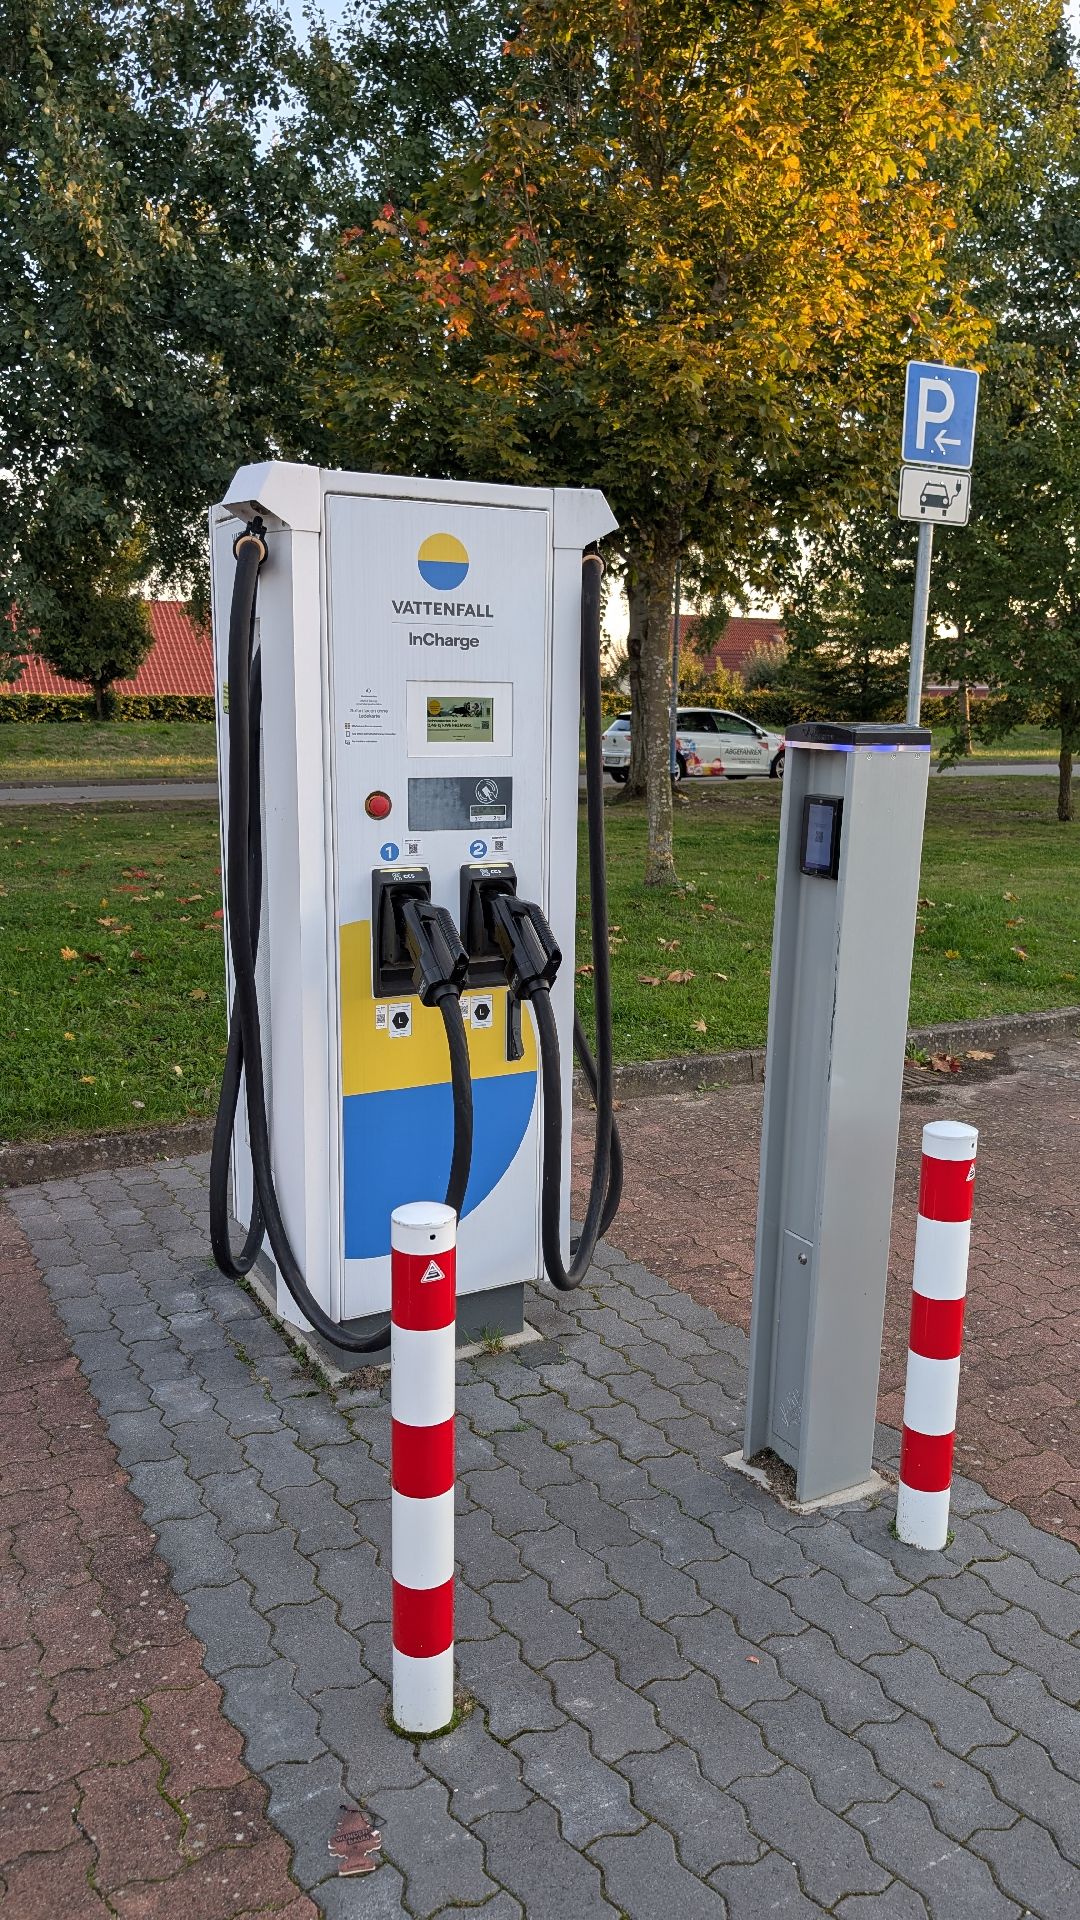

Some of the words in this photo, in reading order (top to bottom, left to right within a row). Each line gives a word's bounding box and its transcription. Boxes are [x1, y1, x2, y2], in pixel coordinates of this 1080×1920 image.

[916, 377, 955, 449] P
[392, 600, 494, 618] VATTENFALL
[409, 632, 480, 650] InCharge
[385, 846, 393, 859] 1
[473, 842, 484, 856] 2
[479, 1008, 485, 1016] L
